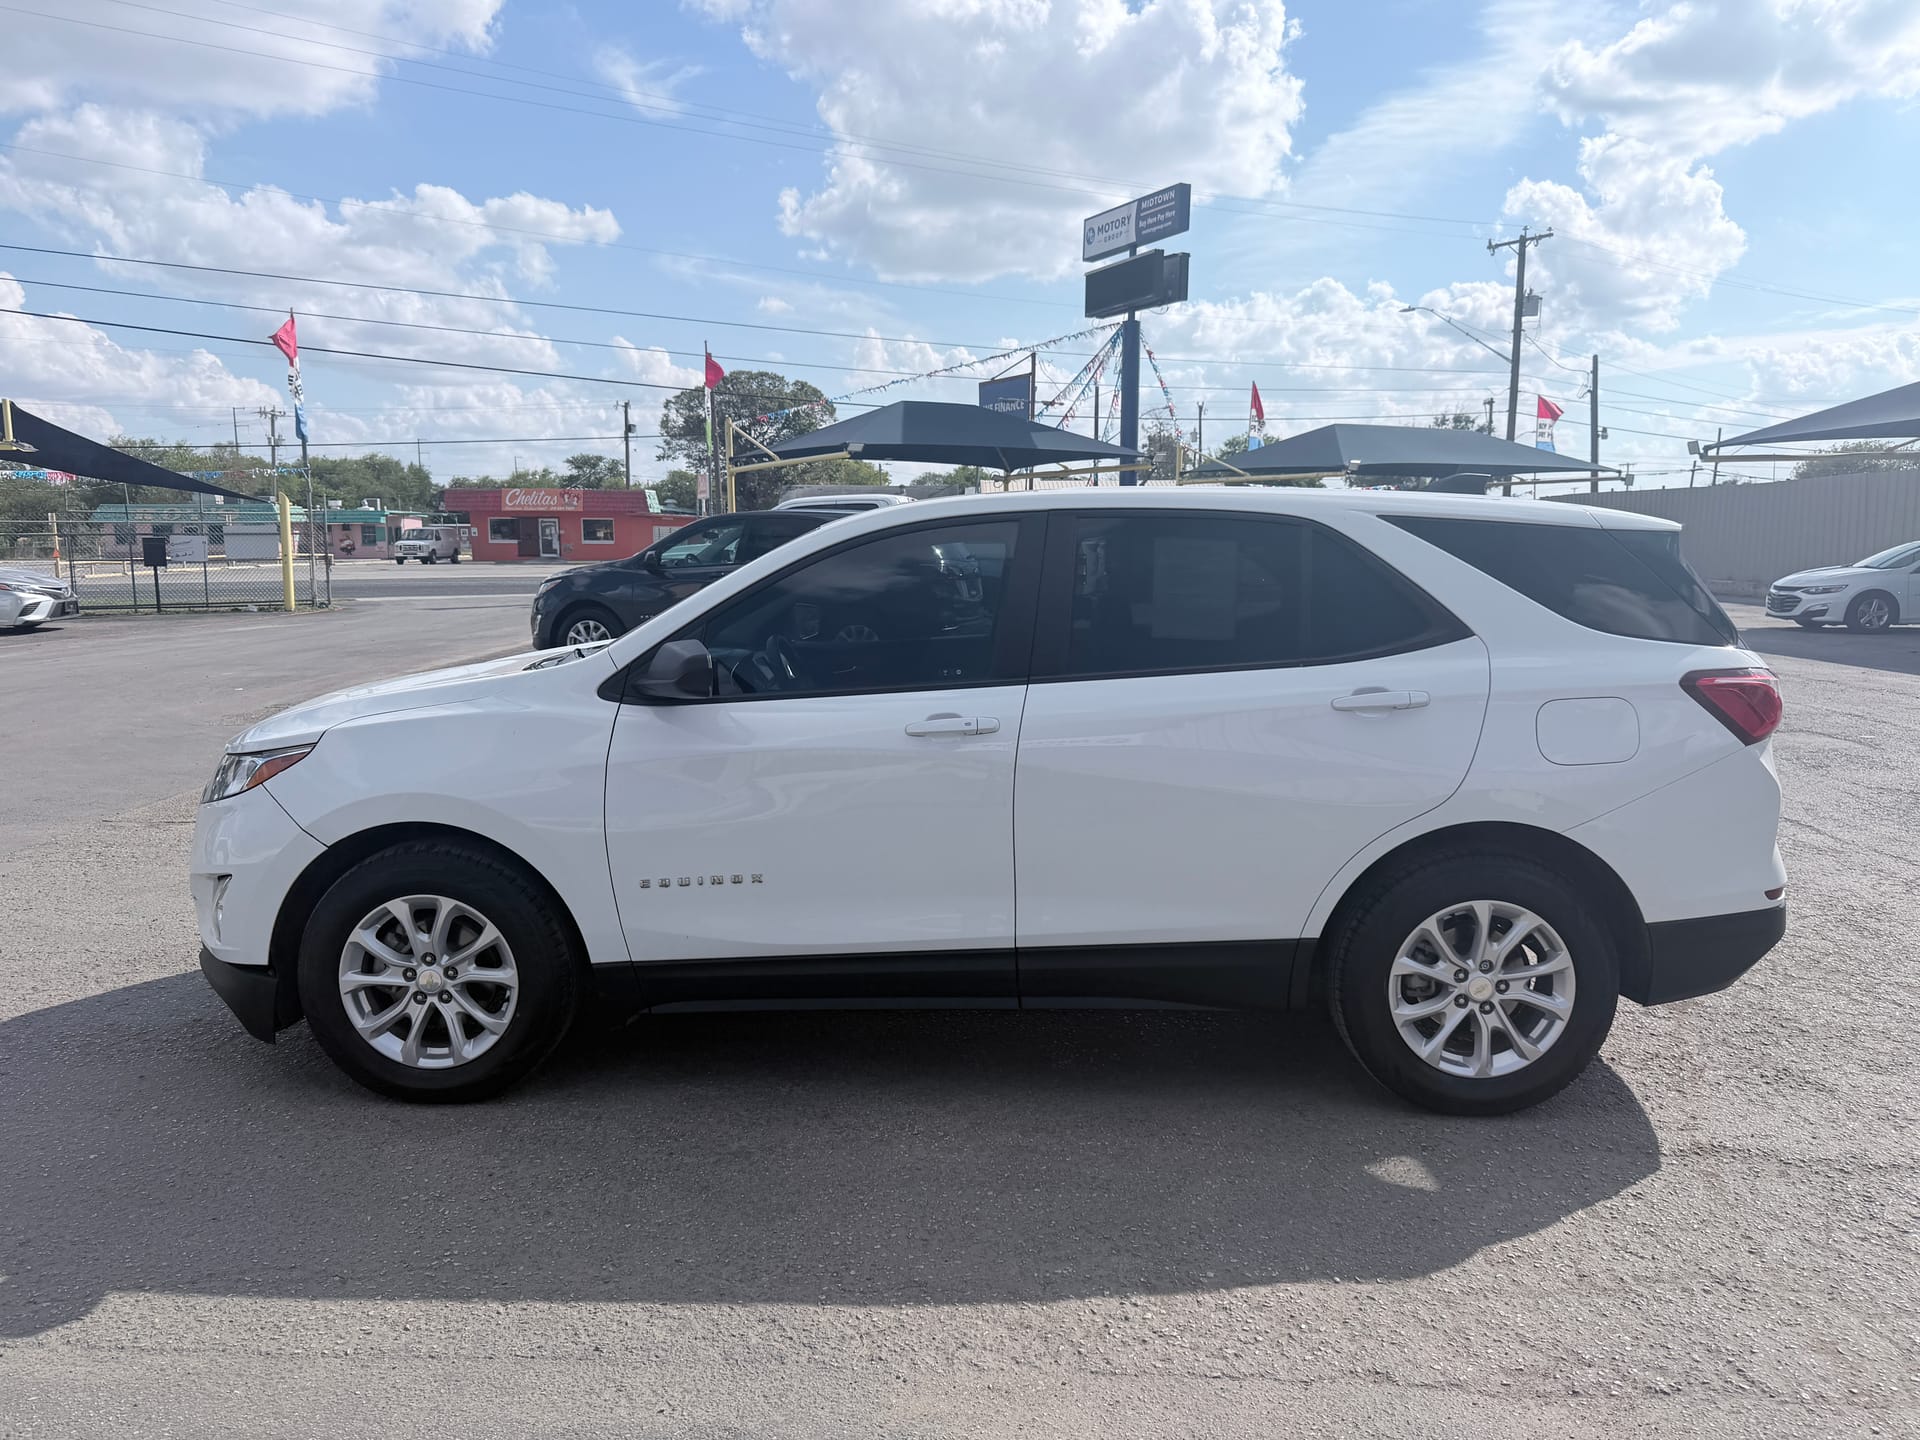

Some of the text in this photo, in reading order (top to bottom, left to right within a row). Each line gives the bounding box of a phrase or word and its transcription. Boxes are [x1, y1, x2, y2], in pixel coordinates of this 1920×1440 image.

[1141, 190, 1175, 210] MIDTOWN
[1097, 213, 1132, 236] MOTORY
[1104, 231, 1123, 243] GROUP
[994, 400, 1025, 413] FINANCE
[505, 488, 558, 506] Chelitas
[639, 873, 764, 889] EQUINOX
